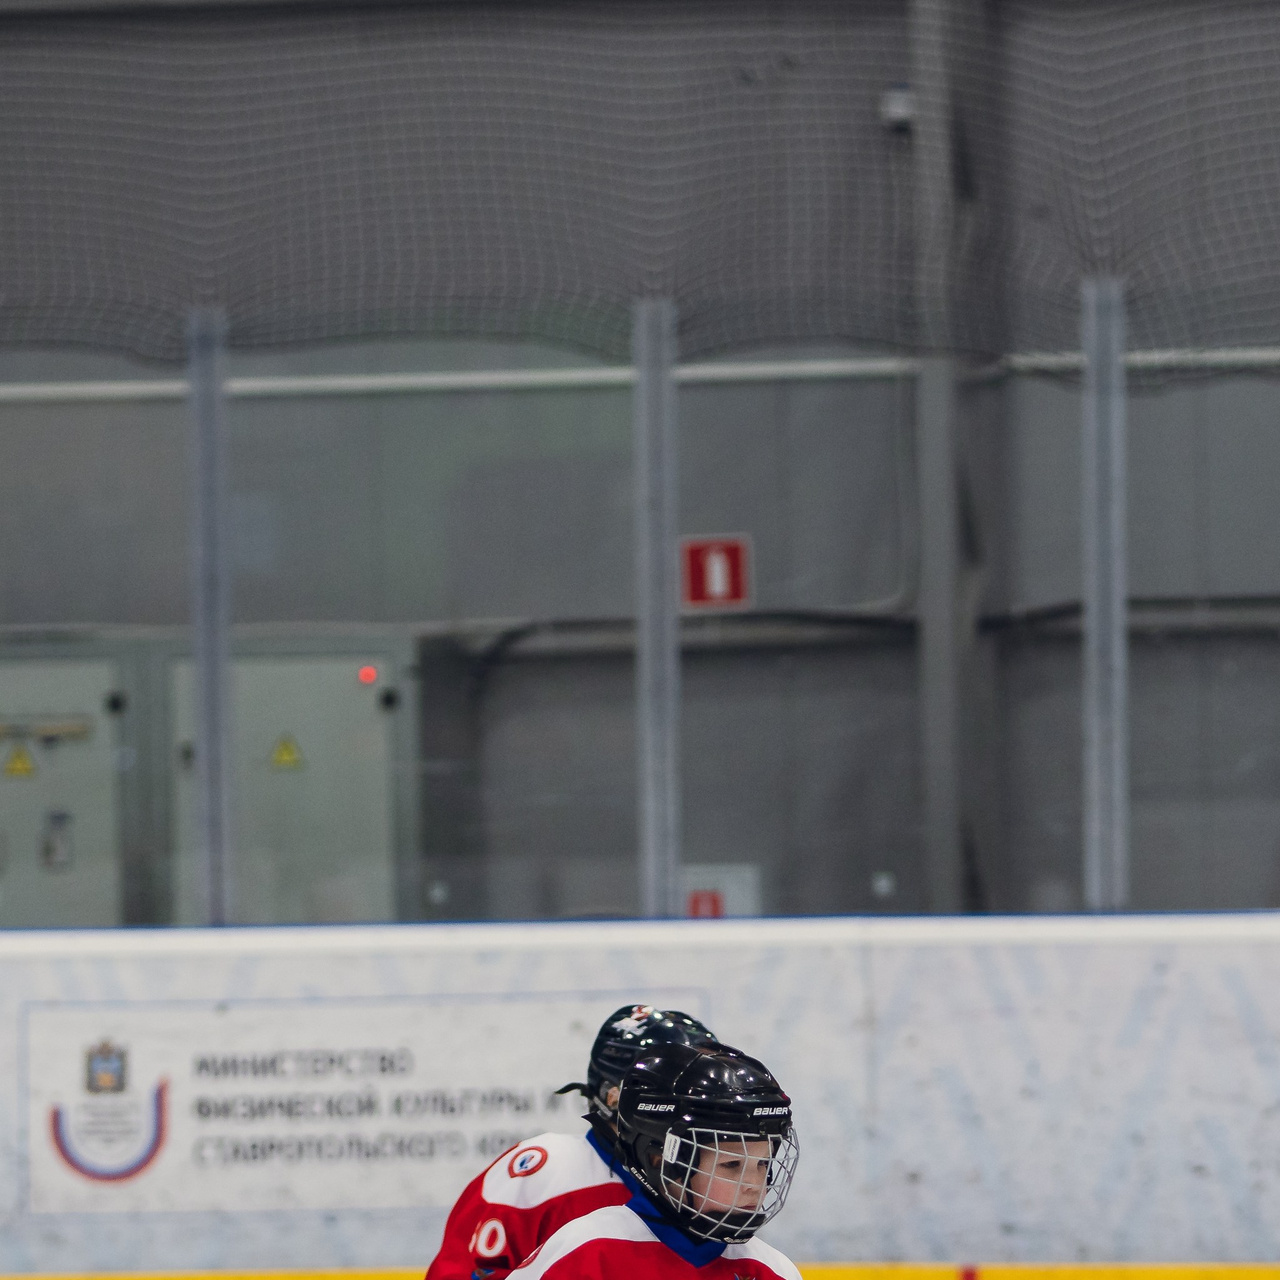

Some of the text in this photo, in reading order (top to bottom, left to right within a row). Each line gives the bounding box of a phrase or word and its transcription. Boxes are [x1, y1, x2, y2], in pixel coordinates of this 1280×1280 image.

[636, 1102, 676, 1112] BAUER
[752, 1106, 790, 1117] BAUER
[630, 1166, 659, 1198] BAUER
